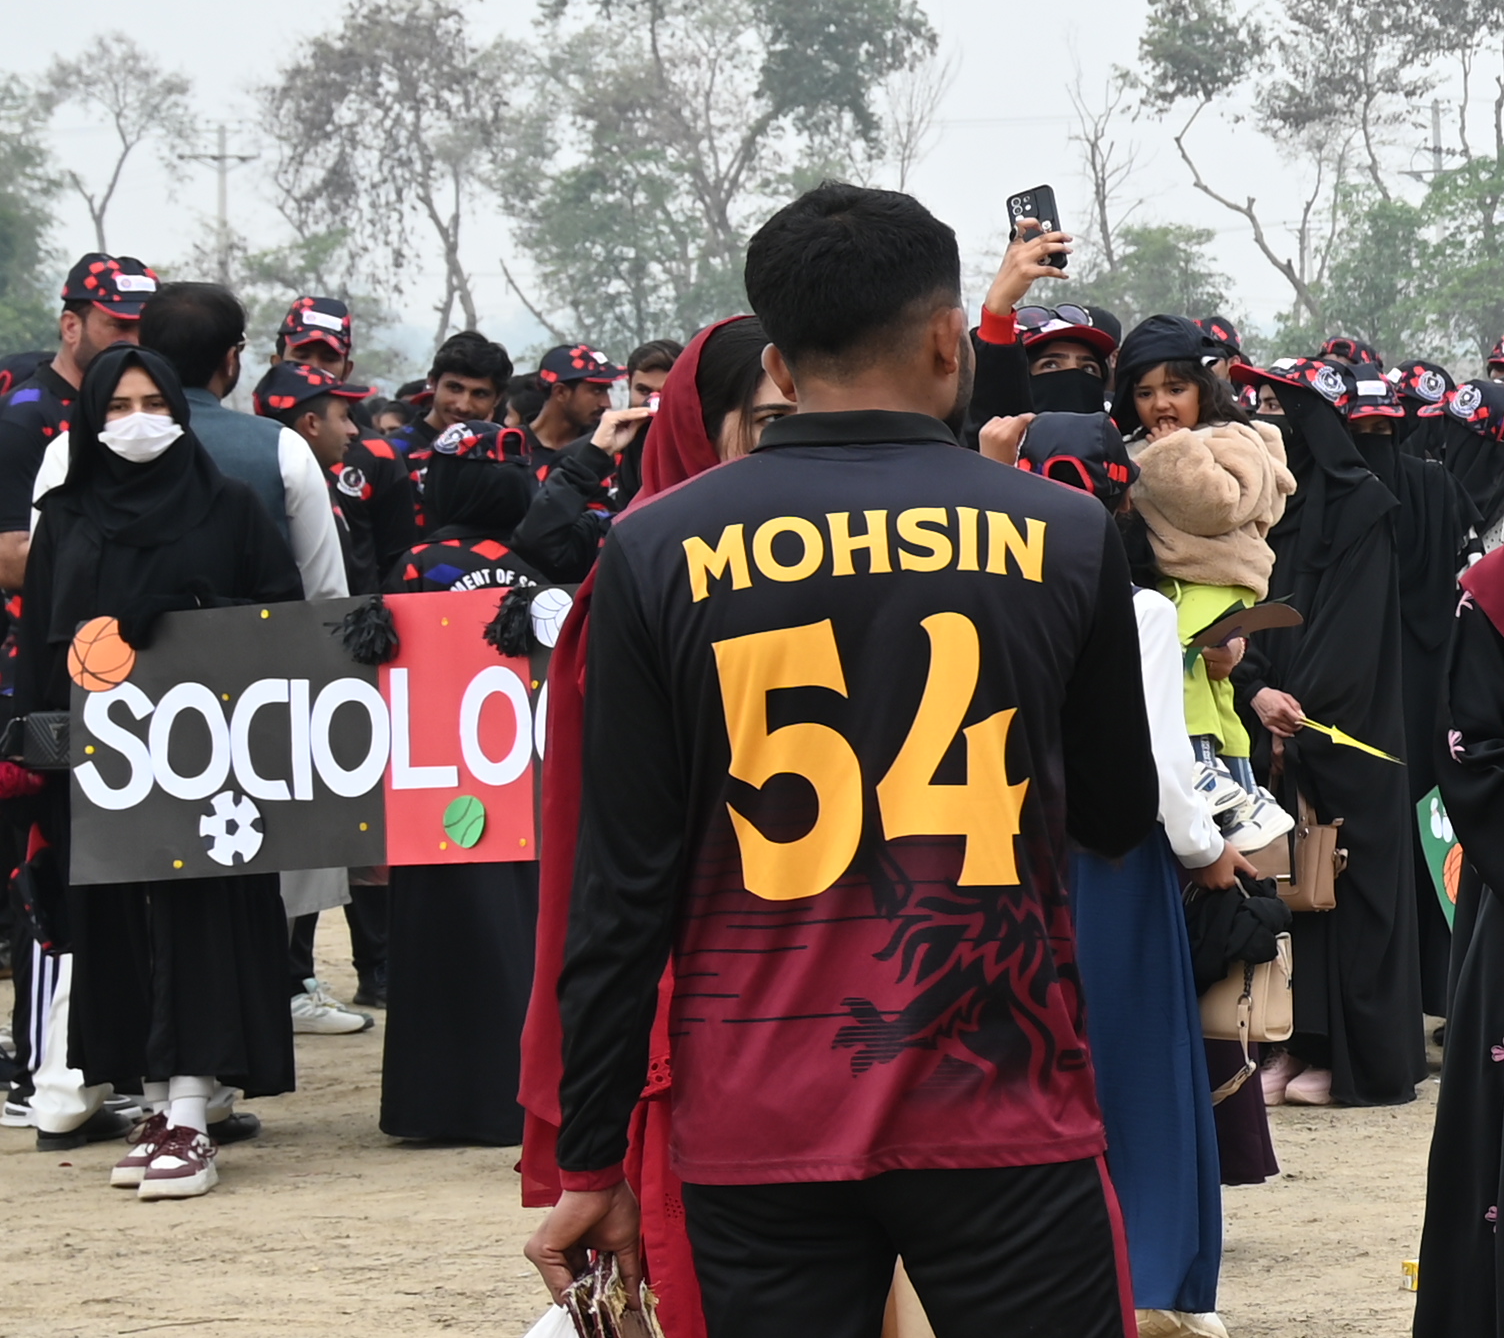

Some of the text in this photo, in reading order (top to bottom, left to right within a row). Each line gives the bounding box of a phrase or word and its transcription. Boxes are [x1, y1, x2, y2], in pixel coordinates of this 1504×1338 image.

[495, 568, 515, 585] OF
[682, 506, 1047, 604] MOHSIN
[73, 665, 548, 810] SOCIOLO
[711, 612, 1030, 901] 54
